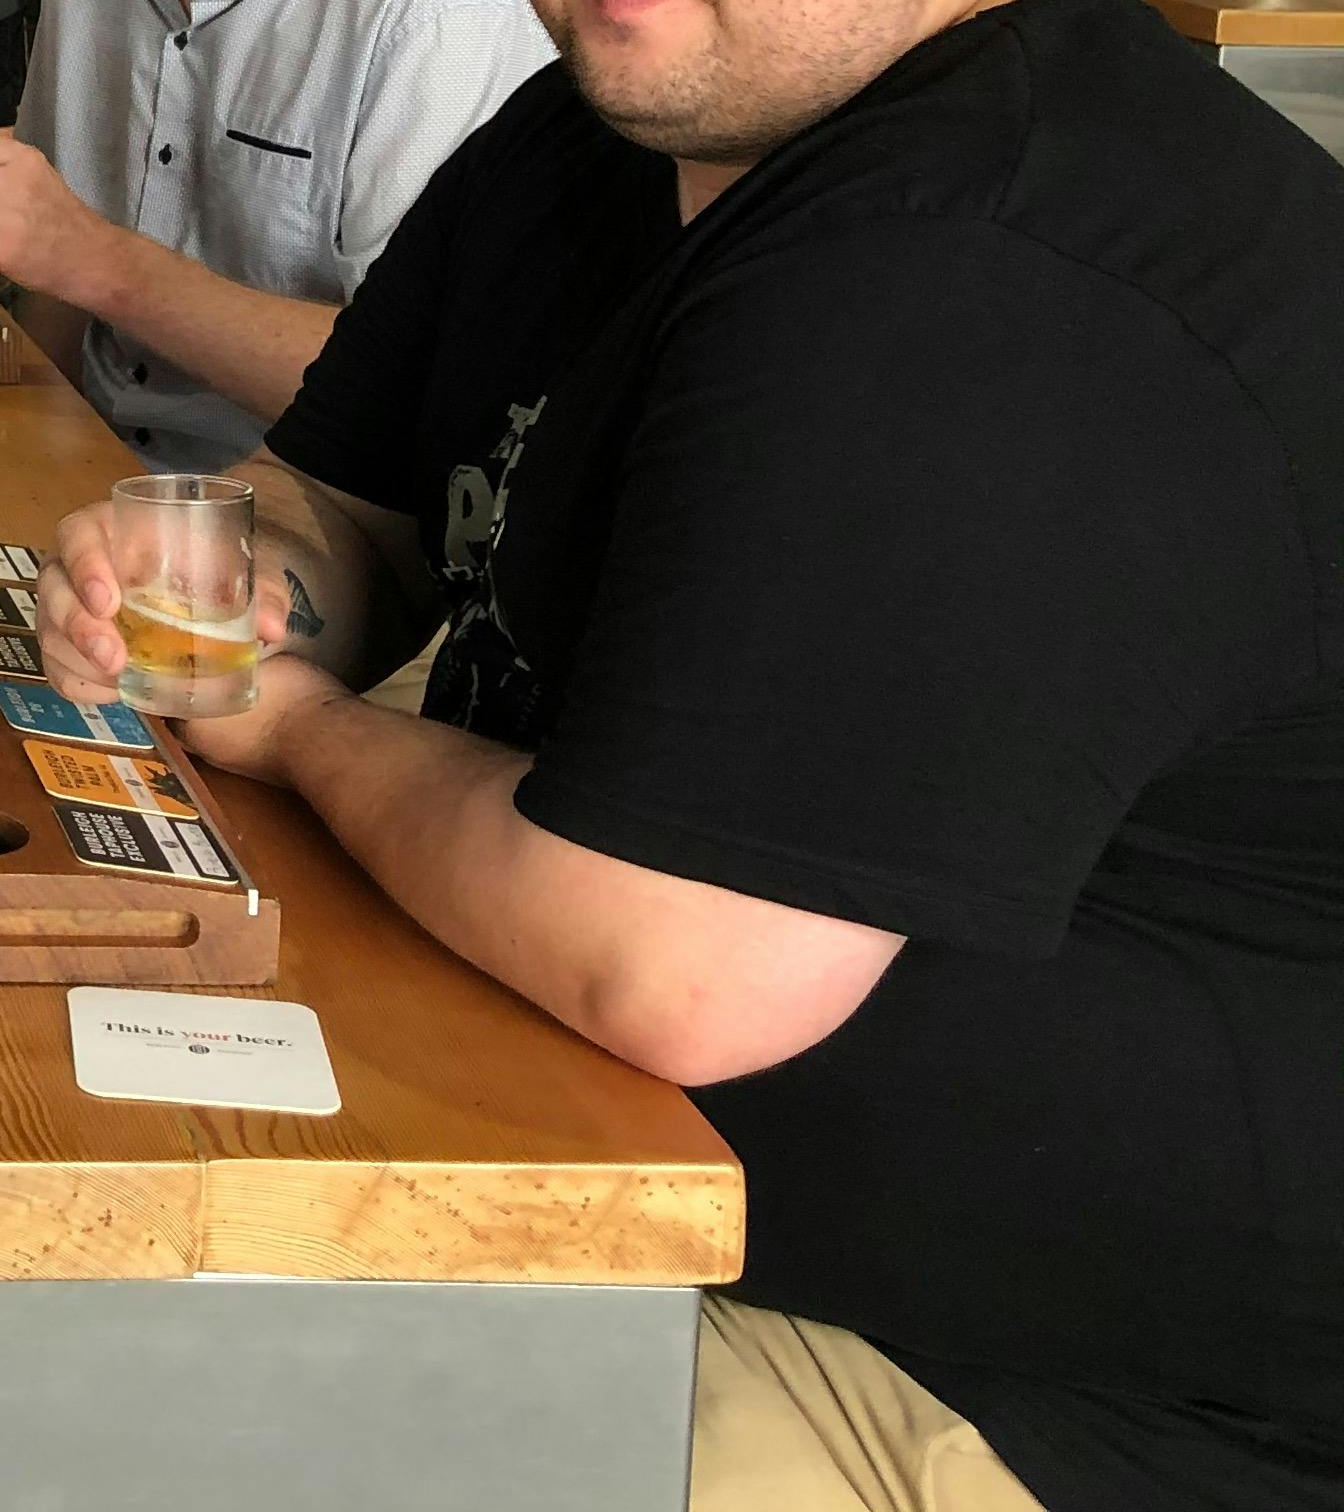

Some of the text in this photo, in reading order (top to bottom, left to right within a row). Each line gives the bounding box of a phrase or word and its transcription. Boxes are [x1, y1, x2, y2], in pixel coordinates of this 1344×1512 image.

[43, 749, 75, 789] BURLEIGH
[61, 755, 86, 788] TWISTED
[81, 764, 102, 787] PALM
[71, 811, 107, 856] BURLEIGH
[89, 812, 126, 859] TAPHOUSE
[107, 814, 146, 863] EXCLUSIVE
[102, 1022, 293, 1047] This is your beer.
